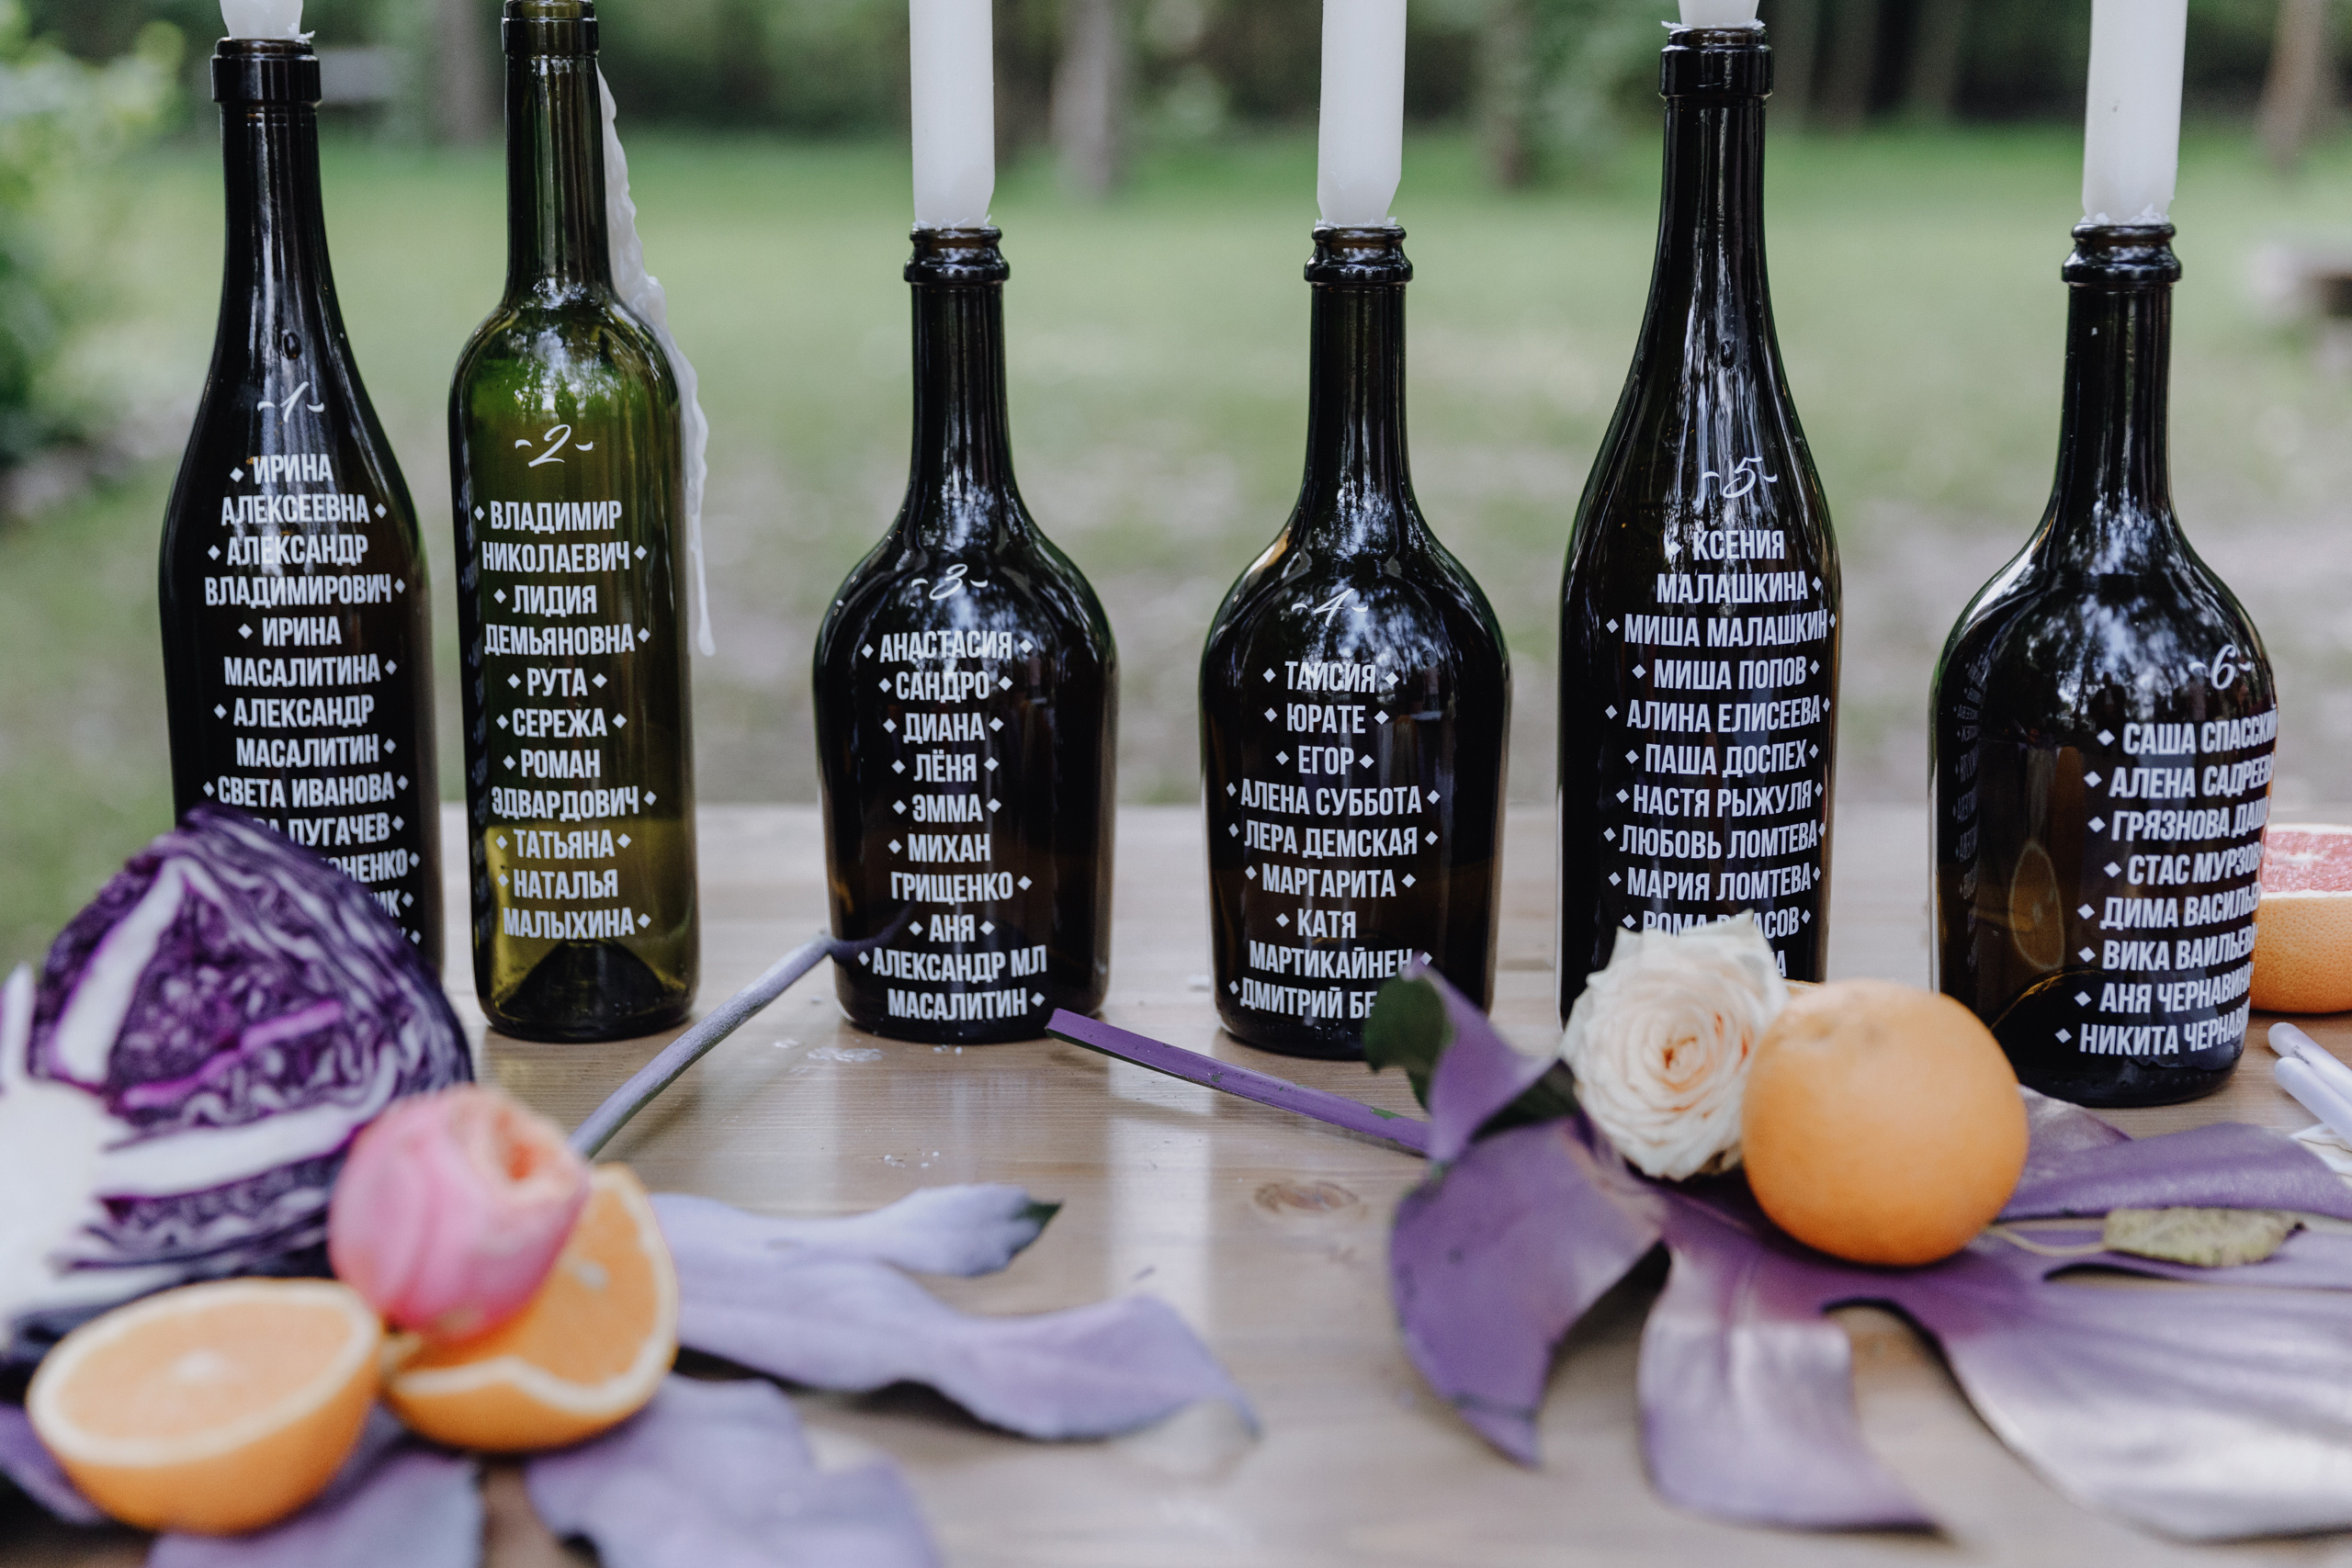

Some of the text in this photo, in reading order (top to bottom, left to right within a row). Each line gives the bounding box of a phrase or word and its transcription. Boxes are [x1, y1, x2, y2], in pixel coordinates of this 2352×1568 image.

[254, 454, 334, 484] ИРИНА
[220, 494, 370, 525] АЛЕКСЕЕВНА
[490, 501, 622, 534] ВЛАДИМИР
[227, 534, 368, 566] АЛЕКСАНДР
[481, 540, 630, 573] НИКОЛАЕВИЧ
[1693, 529, 1785, 561] КСЕНИЯ
[205, 574, 391, 608] ВЛАДИМИРОВИЧ
[512, 584, 597, 617] ЛИДИЯ
[1657, 570, 1809, 604] МАЛАШКИНА
[263, 616, 342, 646] ИРИНА
[484, 624, 636, 656] ДЕМЬЯНОВНА
[1624, 608, 1827, 648] МИША МАЛАШКИН
[879, 630, 1012, 663] АНАСТАСИЯ
[223, 653, 381, 687] МАСАЛИТИНА
[526, 667, 588, 697] РУТА
[1284, 660, 1376, 694] ТАИСИЯ
[1654, 655, 1807, 691] МИША ПОПОВ
[896, 671, 989, 704] САНДРО
[233, 694, 375, 728] АЛЕКСАНДР
[512, 707, 608, 738] СЕРЕЖА
[1287, 703, 1366, 734] ЮРАТЕ
[1626, 694, 1821, 733] АЛИНА ЕЛИСЕЕВА
[903, 712, 986, 744] ДИАНА
[2122, 722, 2197, 755] САША
[235, 733, 379, 768] МАСАЛИТИН
[520, 749, 601, 779] РОМАН
[913, 749, 978, 783] ЛЁНЯ
[1298, 745, 1354, 775] ЕГОР
[1645, 739, 1807, 778] ПАША ДОСПЕХ
[217, 772, 395, 807] СВЕТА ИВАНОВА
[2109, 751, 2275, 799] АЛЕНА САДРЕЕВ
[491, 785, 639, 822] ЭДВАРДОВИЧ
[911, 794, 984, 823] ЭММА
[1240, 778, 1422, 817] АЛЕНА СУББОТА
[1633, 779, 1813, 818] НАСТЯ РЫЖУЛЯ
[288, 812, 390, 846] ПУГАЧЕВ
[1244, 819, 1418, 860] ЛЕРА ДЕМСКАЯ
[1619, 819, 1818, 860] ЛЮБОВЬ ЛОМТЕВА
[2111, 807, 2230, 841] ГРЯЗНОВА
[513, 829, 616, 860] ТАТЬЯНА
[908, 833, 991, 863] МИХАН
[513, 869, 618, 899] НАТАЛЬЯ
[1262, 863, 1396, 898] МАРГАРИТА
[1627, 862, 1812, 901] МАРИЯ ЛОМТЕВА
[2127, 853, 2190, 886] СТАС
[890, 872, 1013, 906] ГРИЩЕНКО
[503, 907, 636, 940] МАЛЫХИНА
[929, 914, 976, 942] АНЯ
[1297, 908, 1357, 939] КАТЯ
[2099, 896, 2179, 931] ДИМА
[872, 944, 1047, 984] АЛЕКСАНДР МЛ
[2102, 939, 2170, 971] ВИКА
[888, 987, 1027, 1021] МАСАЛИТИН
[1240, 976, 1342, 1019] ДМИТРИЙ
[2098, 982, 2152, 1013] АНЯ
[2079, 1023, 2179, 1055] НИКИТА
